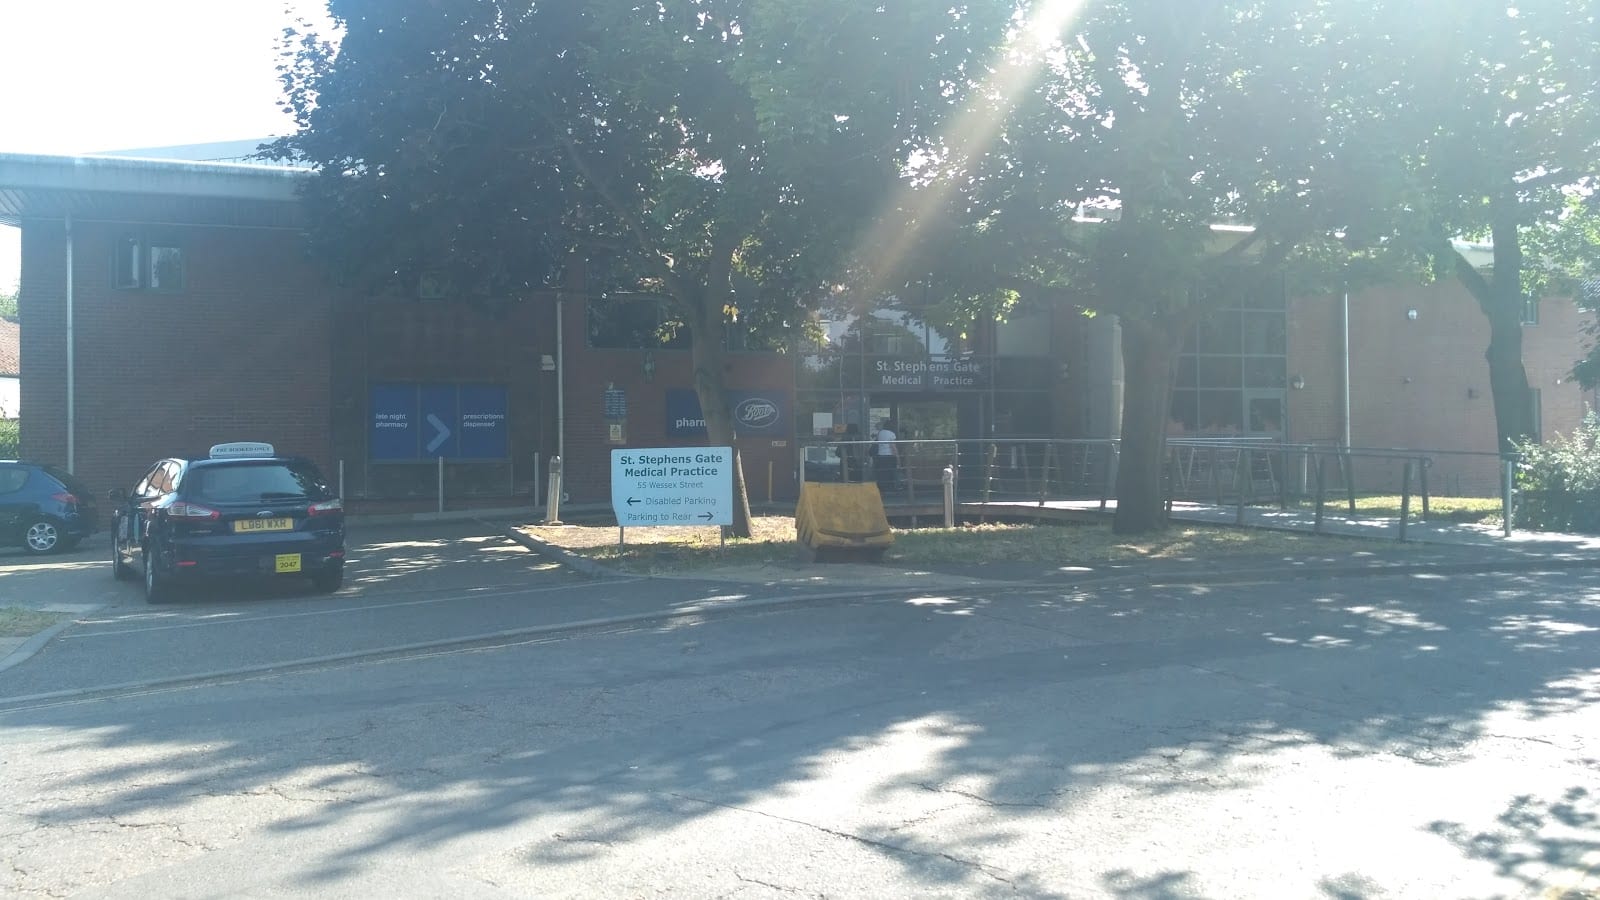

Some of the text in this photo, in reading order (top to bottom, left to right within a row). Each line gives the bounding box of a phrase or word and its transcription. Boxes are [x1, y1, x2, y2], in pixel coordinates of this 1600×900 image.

[876, 360, 980, 374] St. Stephens Gate
[882, 375, 974, 386] Medical Practice
[389, 413, 406, 421] night
[375, 421, 408, 429] pharmacy
[620, 454, 722, 465] St. Stephens Gate
[624, 467, 718, 477] Medical Practice
[645, 497, 717, 507] Disabled Parking
[627, 512, 692, 523] Parking to Rear
